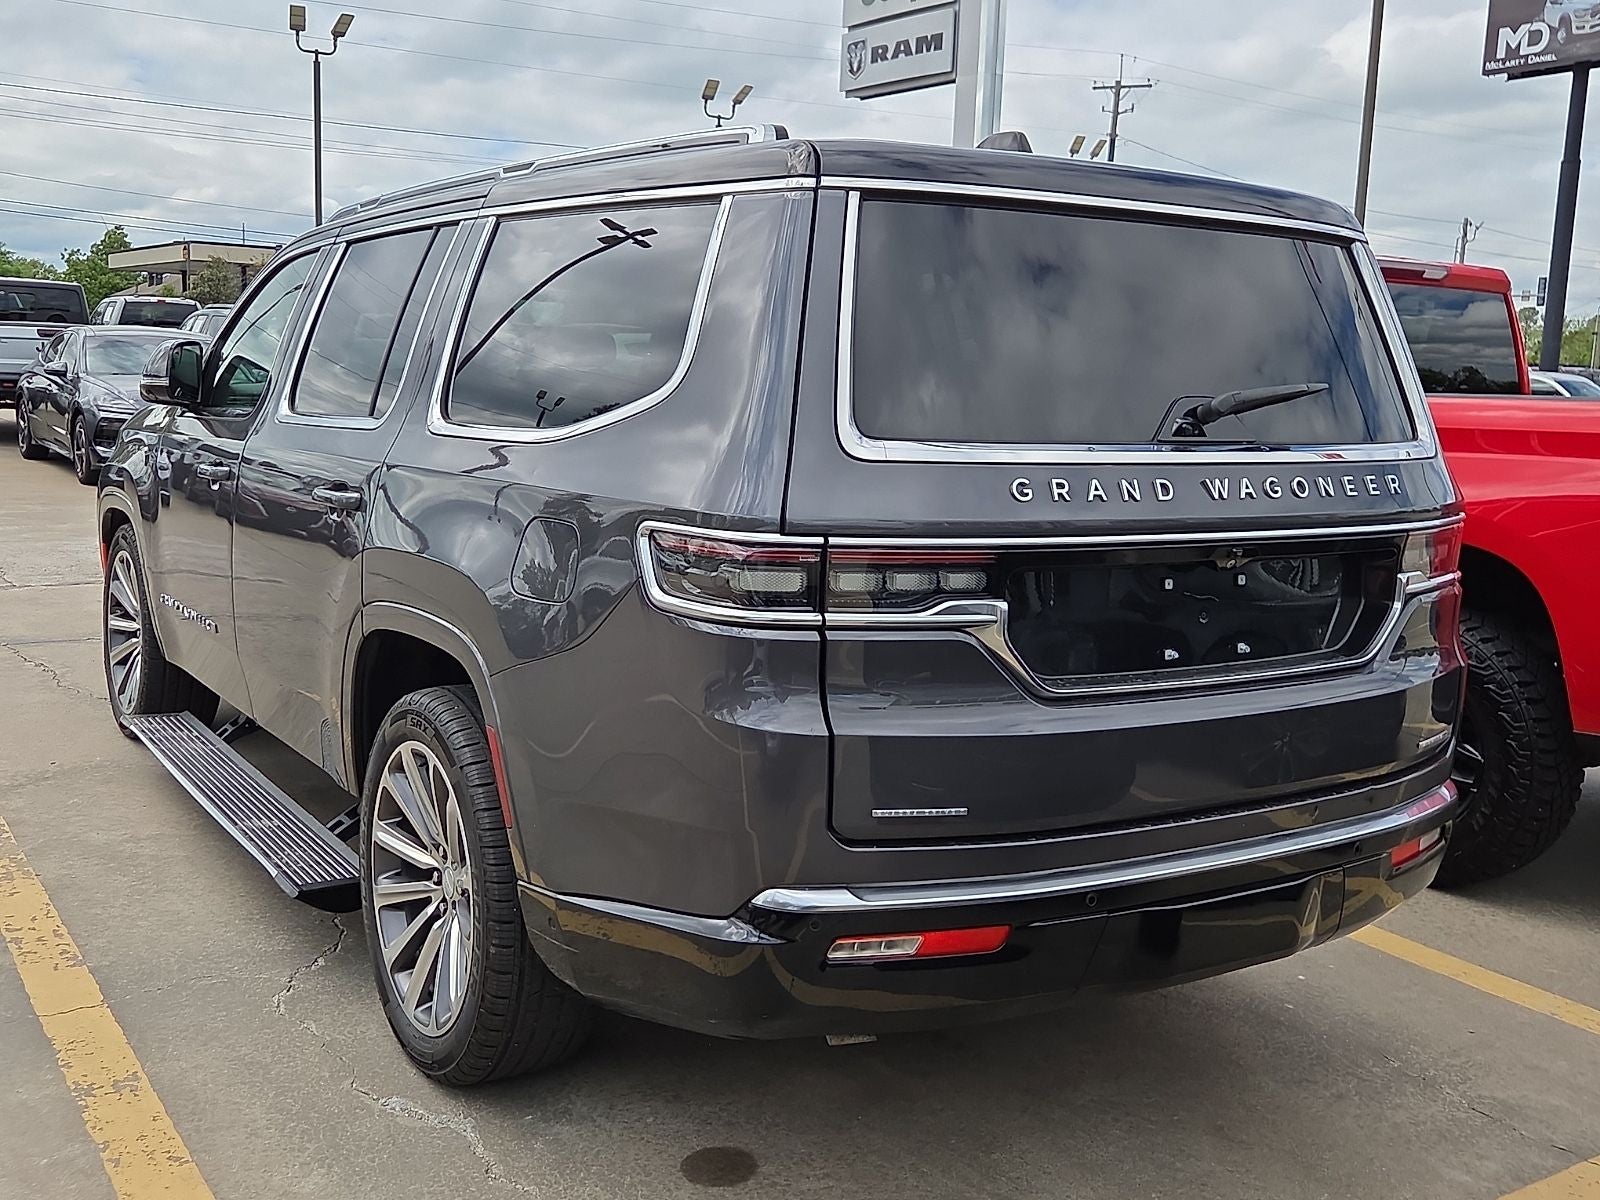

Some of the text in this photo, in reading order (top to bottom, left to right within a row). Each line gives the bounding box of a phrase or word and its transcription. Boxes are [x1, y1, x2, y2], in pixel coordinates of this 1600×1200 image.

[870, 32, 944, 65] RAM
[1496, 21, 1550, 59] MD
[1010, 474, 1402, 503] GRAND WAGONEER
